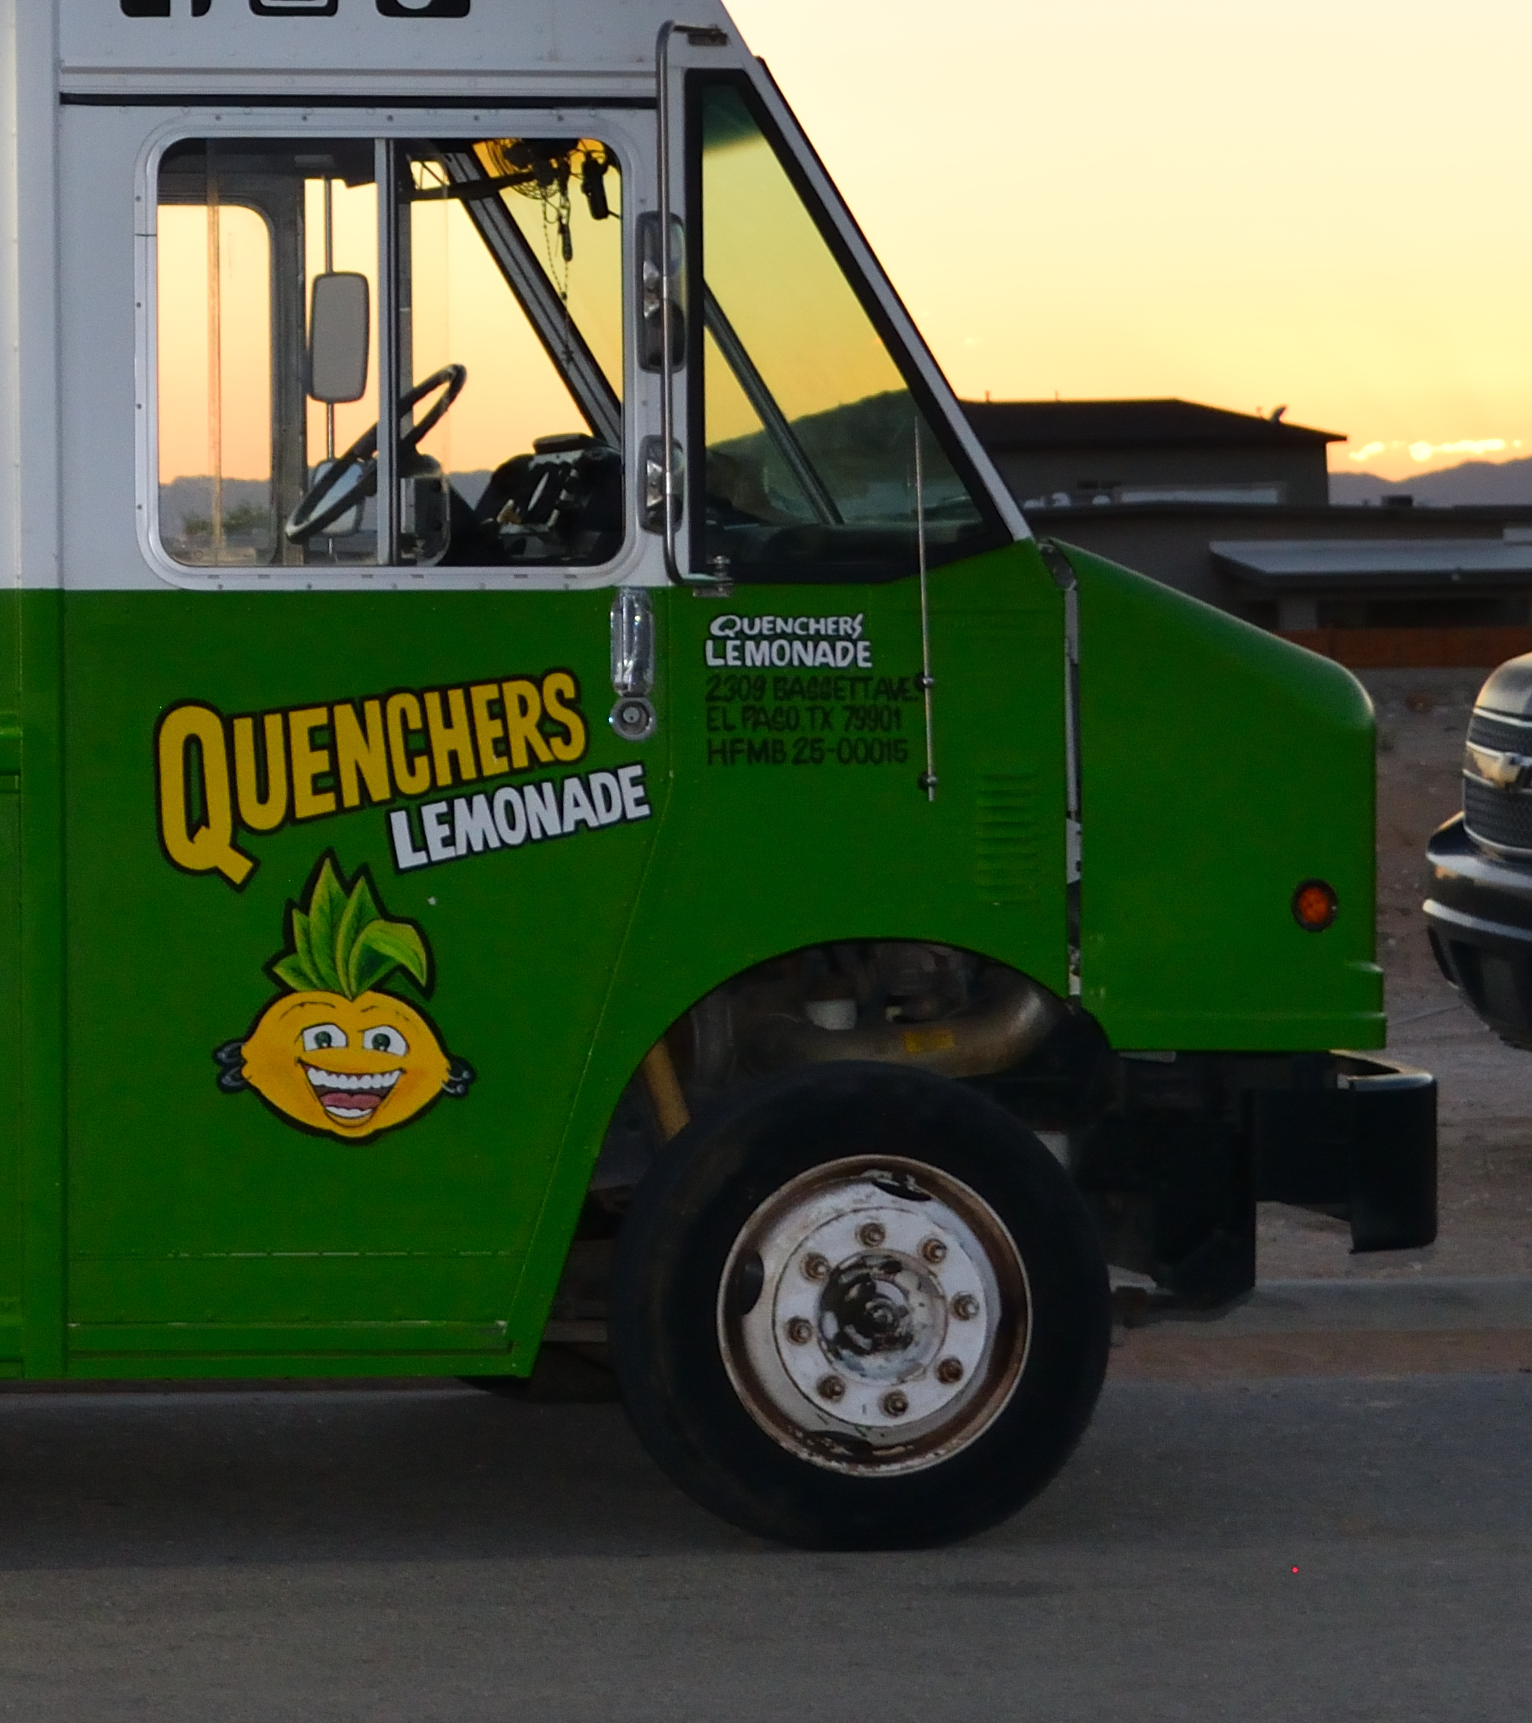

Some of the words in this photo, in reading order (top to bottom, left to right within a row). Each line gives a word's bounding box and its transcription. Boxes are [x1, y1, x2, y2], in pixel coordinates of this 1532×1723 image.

[710, 613, 864, 639] QUENCHERS
[705, 639, 874, 668] LEMONADE
[705, 675, 767, 703] 2309
[706, 706, 736, 732] EL
[806, 706, 834, 731] TX
[843, 705, 902, 732] 79901
[154, 668, 589, 892] QUENCHERS
[388, 763, 654, 874] LEMONADE
